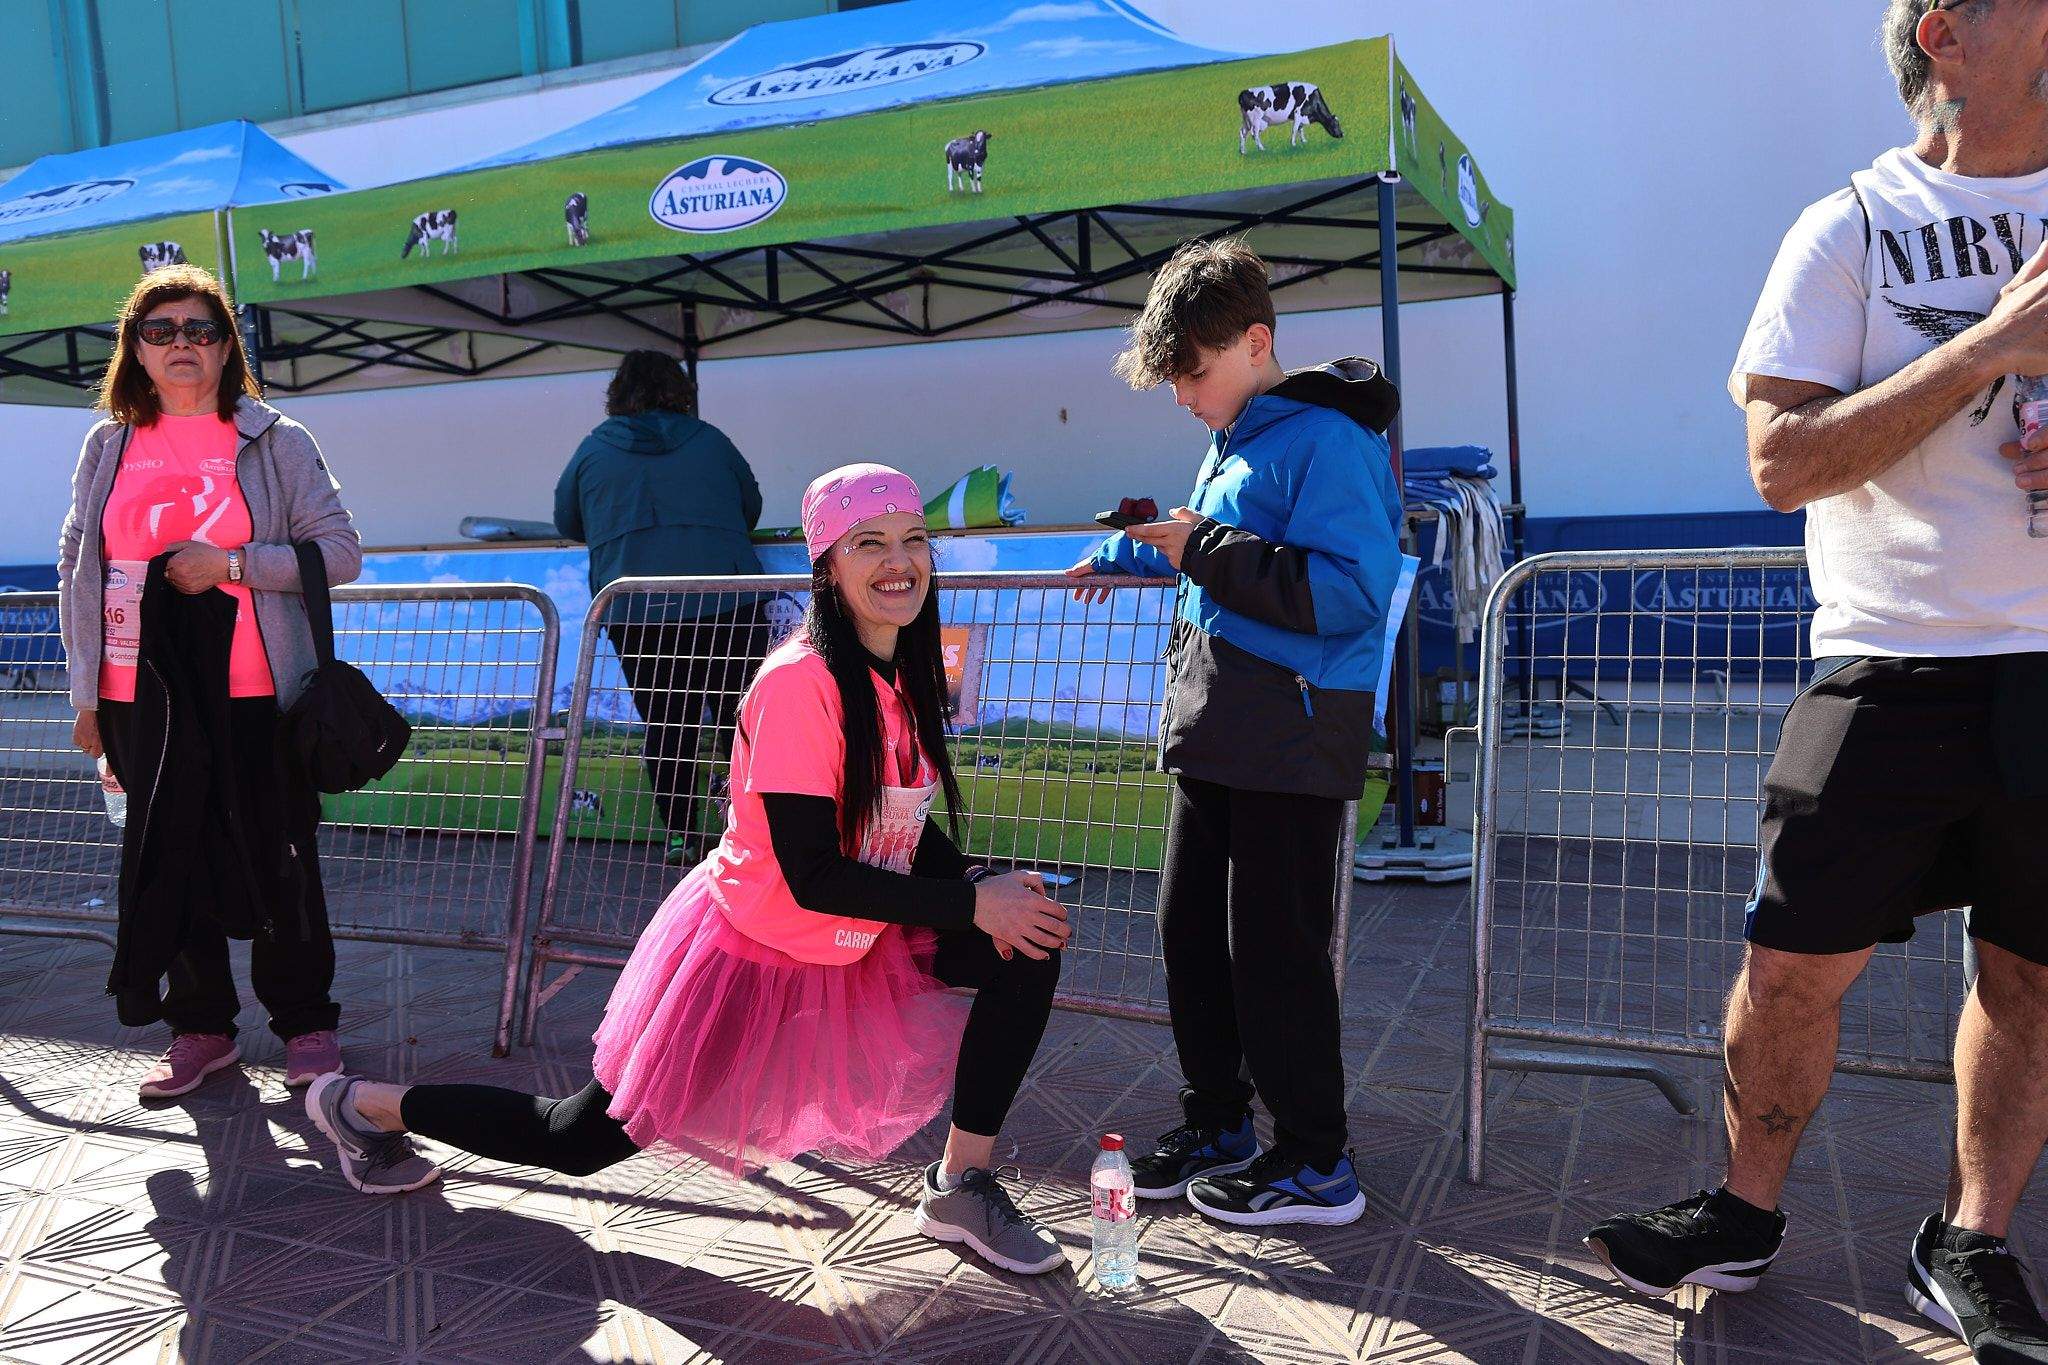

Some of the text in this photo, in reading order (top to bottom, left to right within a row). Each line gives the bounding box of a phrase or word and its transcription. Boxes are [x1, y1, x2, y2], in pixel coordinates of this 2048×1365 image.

[661, 186, 774, 216] ASTURIANA
[1646, 577, 1820, 610] ASTURIAN
[105, 607, 125, 624] 16
